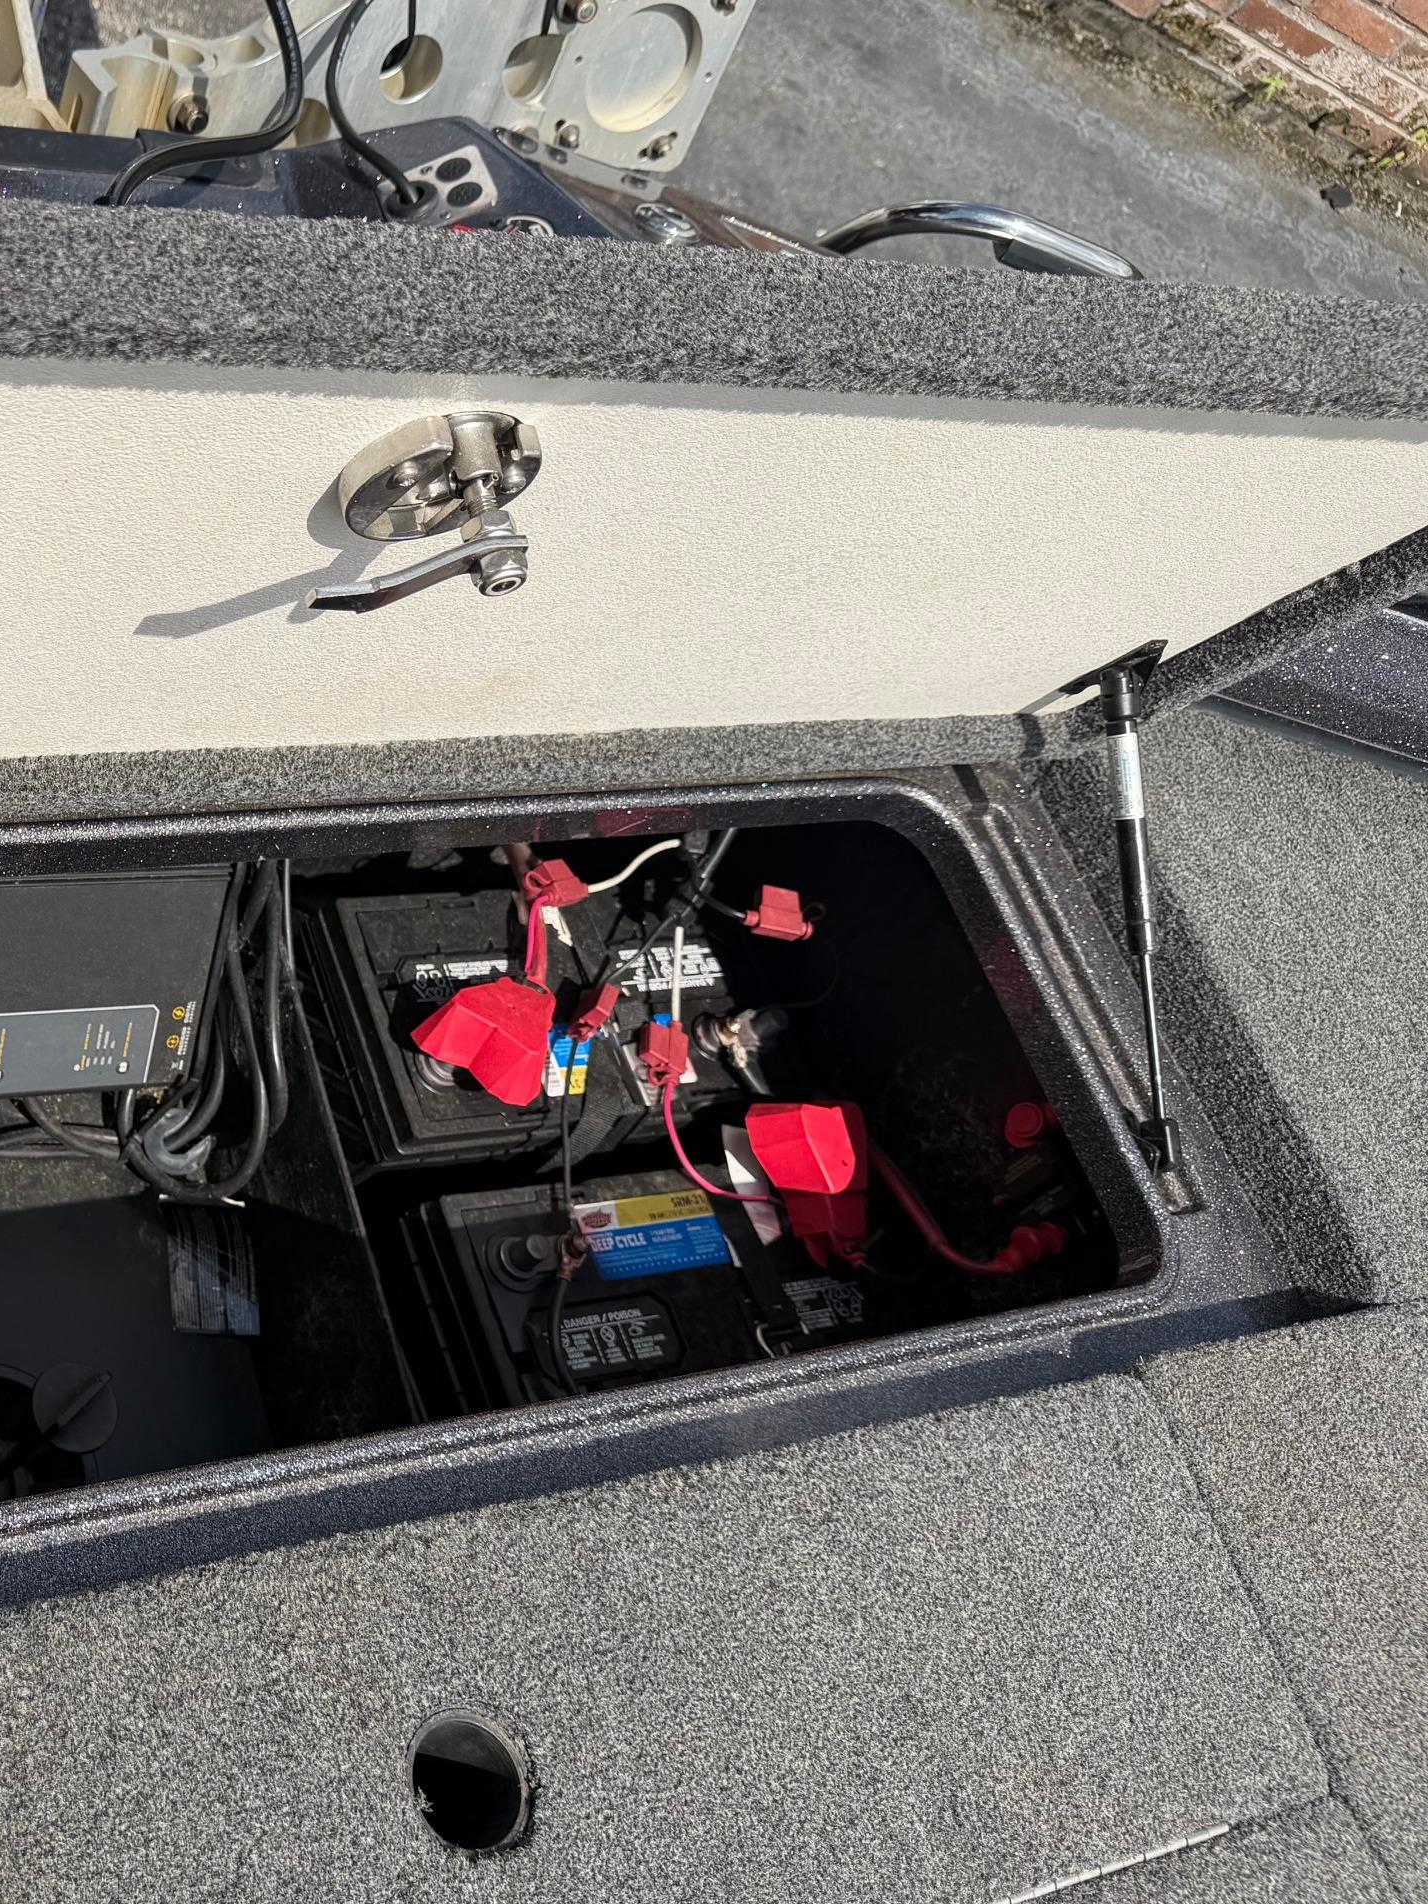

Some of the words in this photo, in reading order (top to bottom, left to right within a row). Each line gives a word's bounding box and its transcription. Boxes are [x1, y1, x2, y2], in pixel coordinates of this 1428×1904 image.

[617, 1232, 647, 1249] CYCLE
[563, 1314, 600, 1328] DANGER
[608, 1309, 642, 1320] POISON
